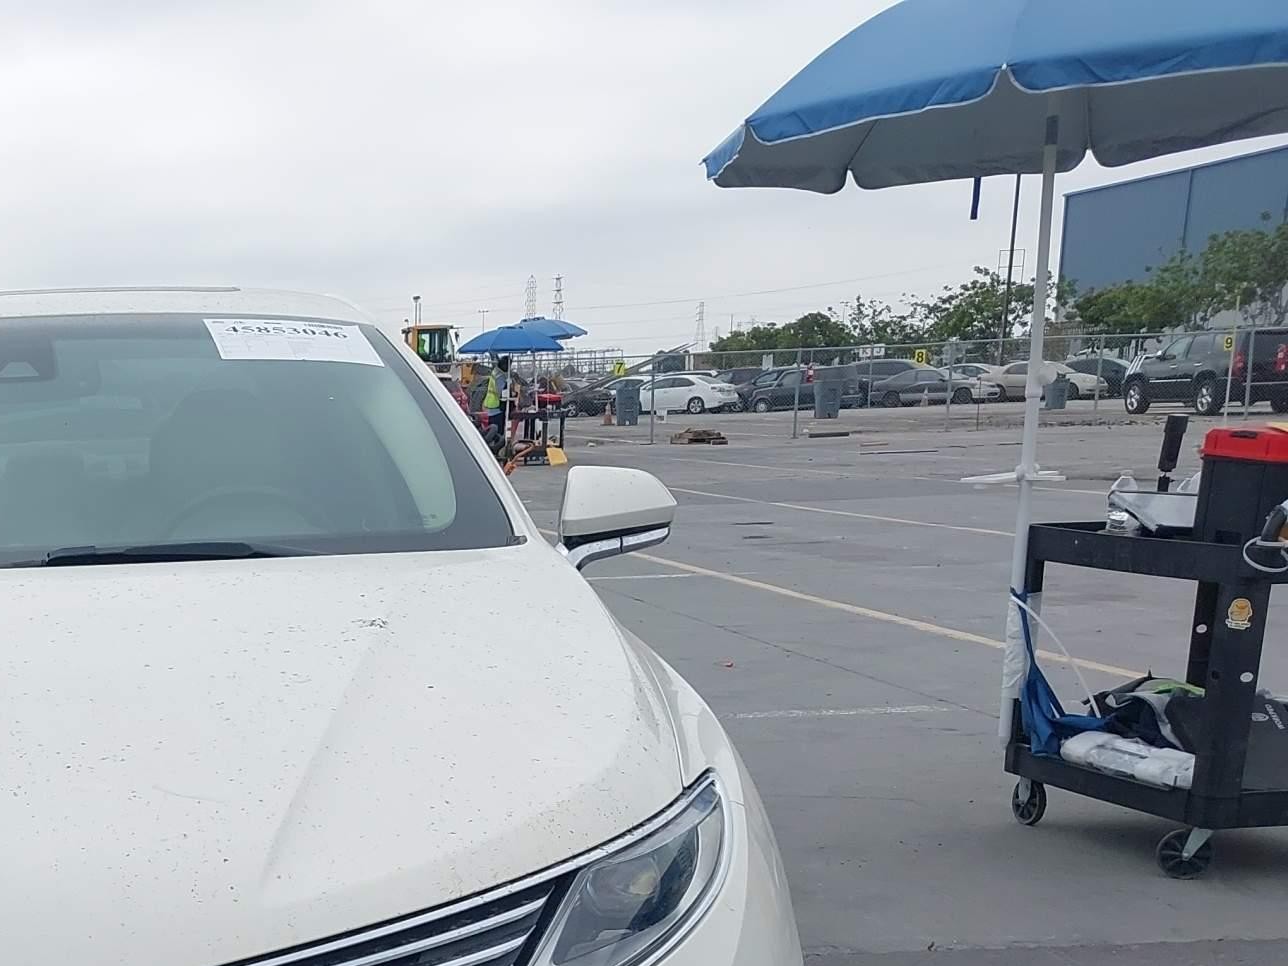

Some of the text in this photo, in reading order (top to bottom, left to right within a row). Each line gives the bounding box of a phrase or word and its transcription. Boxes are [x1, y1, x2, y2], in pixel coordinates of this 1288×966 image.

[224, 325, 348, 340] 45853046
[1225, 336, 1233, 349] 9
[916, 351, 924, 363] 8
[615, 362, 624, 374] 7
